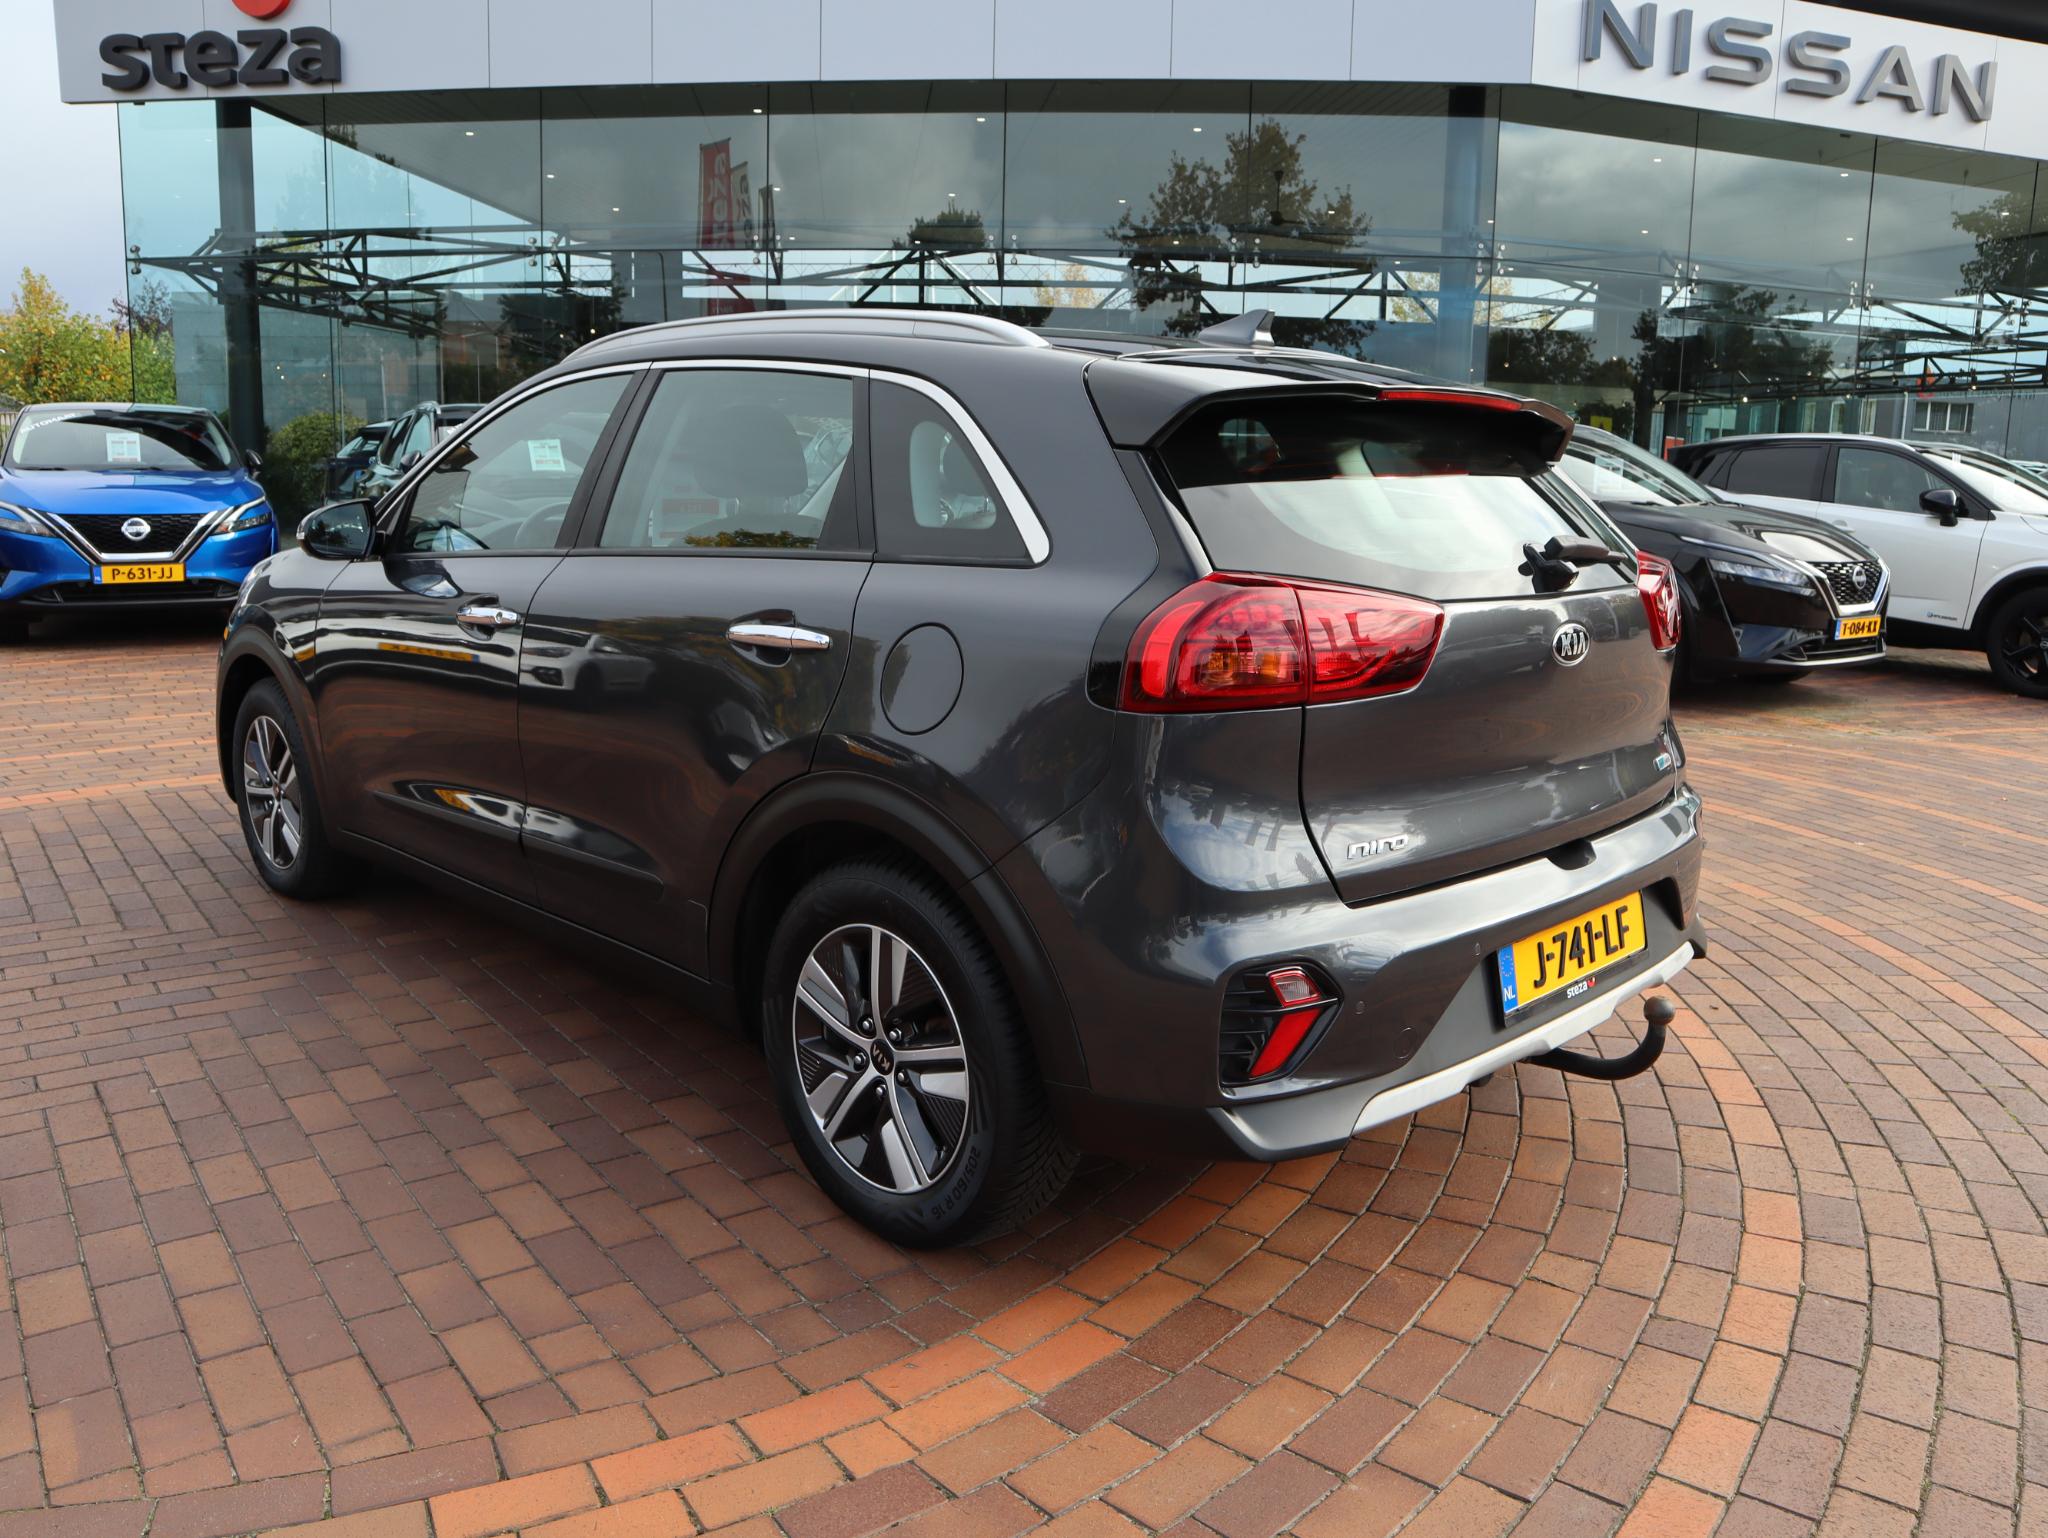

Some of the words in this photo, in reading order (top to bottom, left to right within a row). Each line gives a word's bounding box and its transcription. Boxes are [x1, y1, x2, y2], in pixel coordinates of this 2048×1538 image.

[99, 26, 342, 90] steza
[1584, 0, 1997, 121] NISSAN
[111, 567, 173, 580] P-631-JJ
[1561, 631, 1586, 657] KIA
[1347, 834, 1409, 859] niro
[1533, 905, 1630, 988] J-741-LF
[1504, 984, 1516, 1001] NL
[1566, 980, 1588, 999] steza
[873, 1044, 890, 1071] KIA
